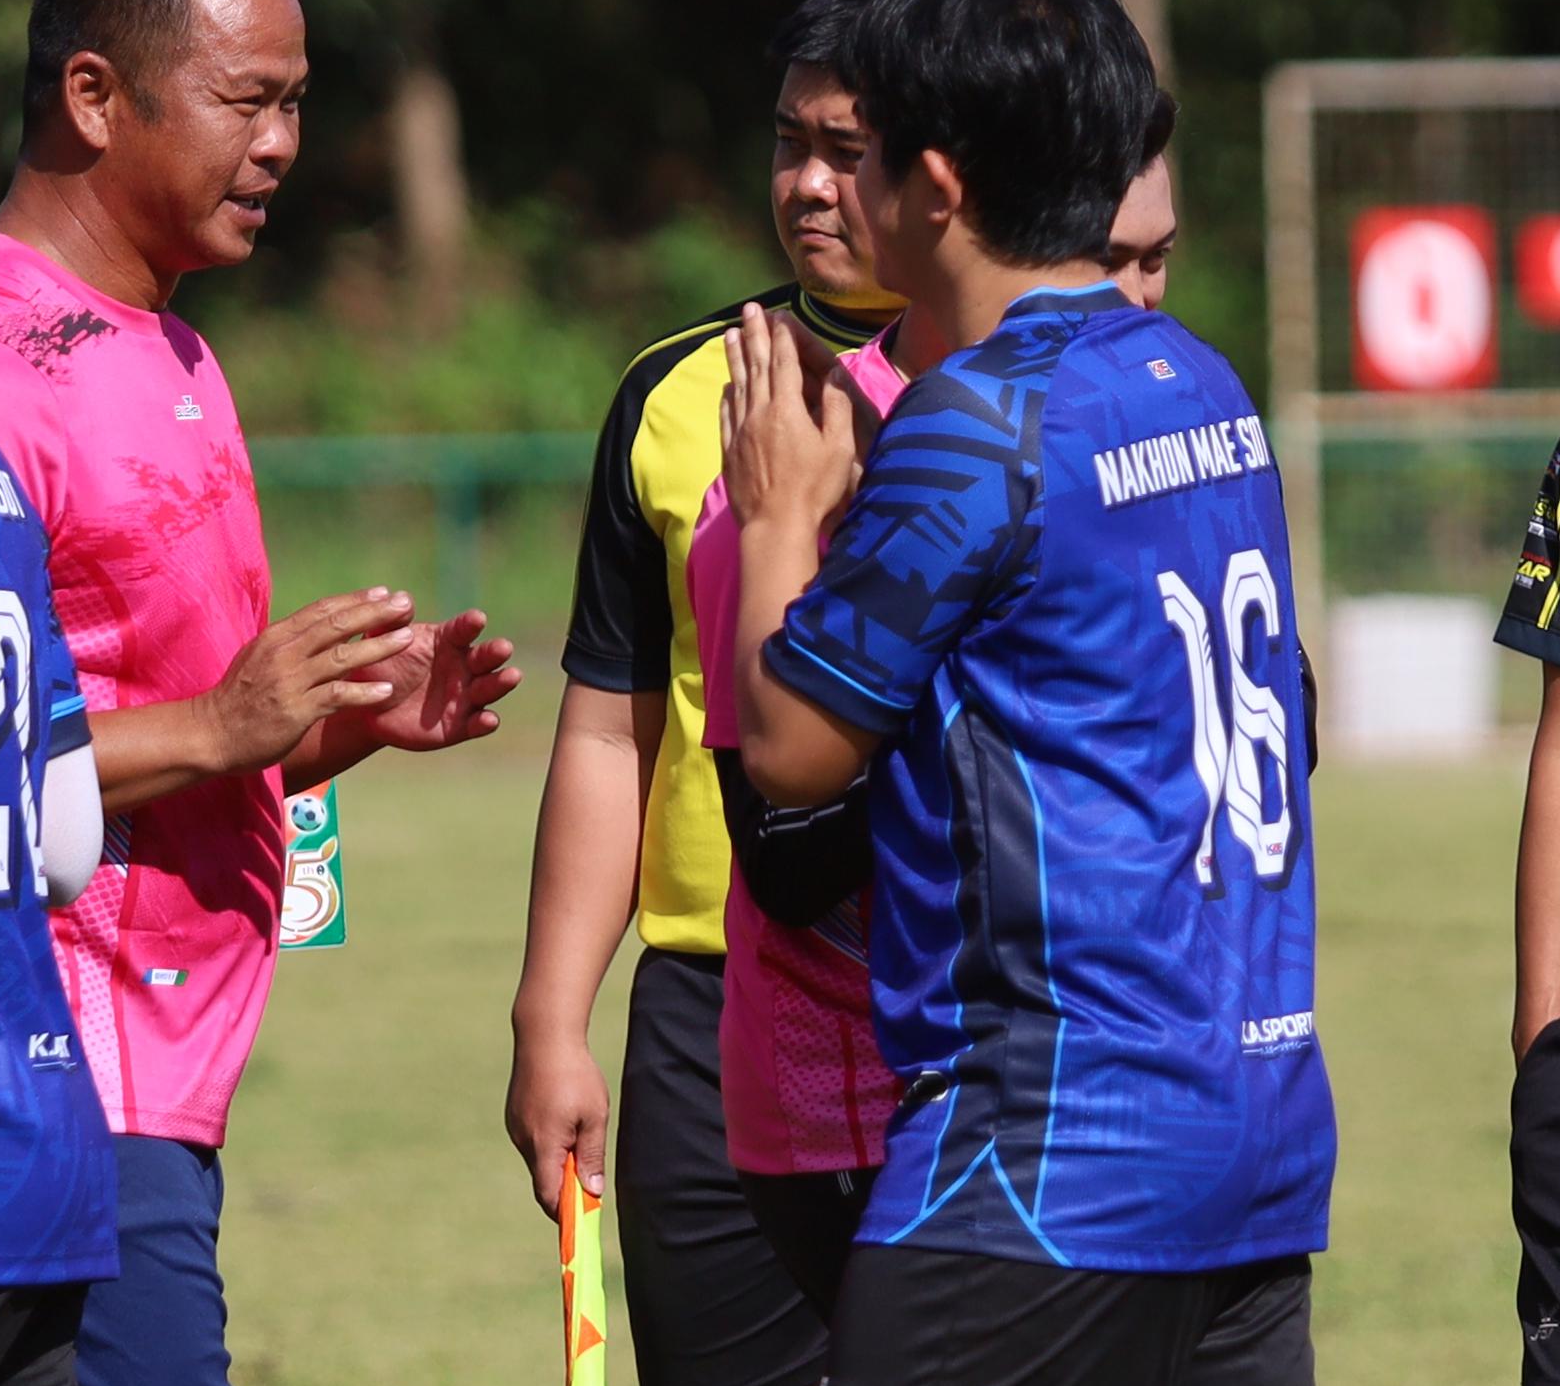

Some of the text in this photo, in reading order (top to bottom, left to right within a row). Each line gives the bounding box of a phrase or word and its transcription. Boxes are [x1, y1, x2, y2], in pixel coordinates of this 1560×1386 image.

[1094, 415, 1270, 505] NAKHON MAE SOT
[1157, 549, 1291, 884] 16
